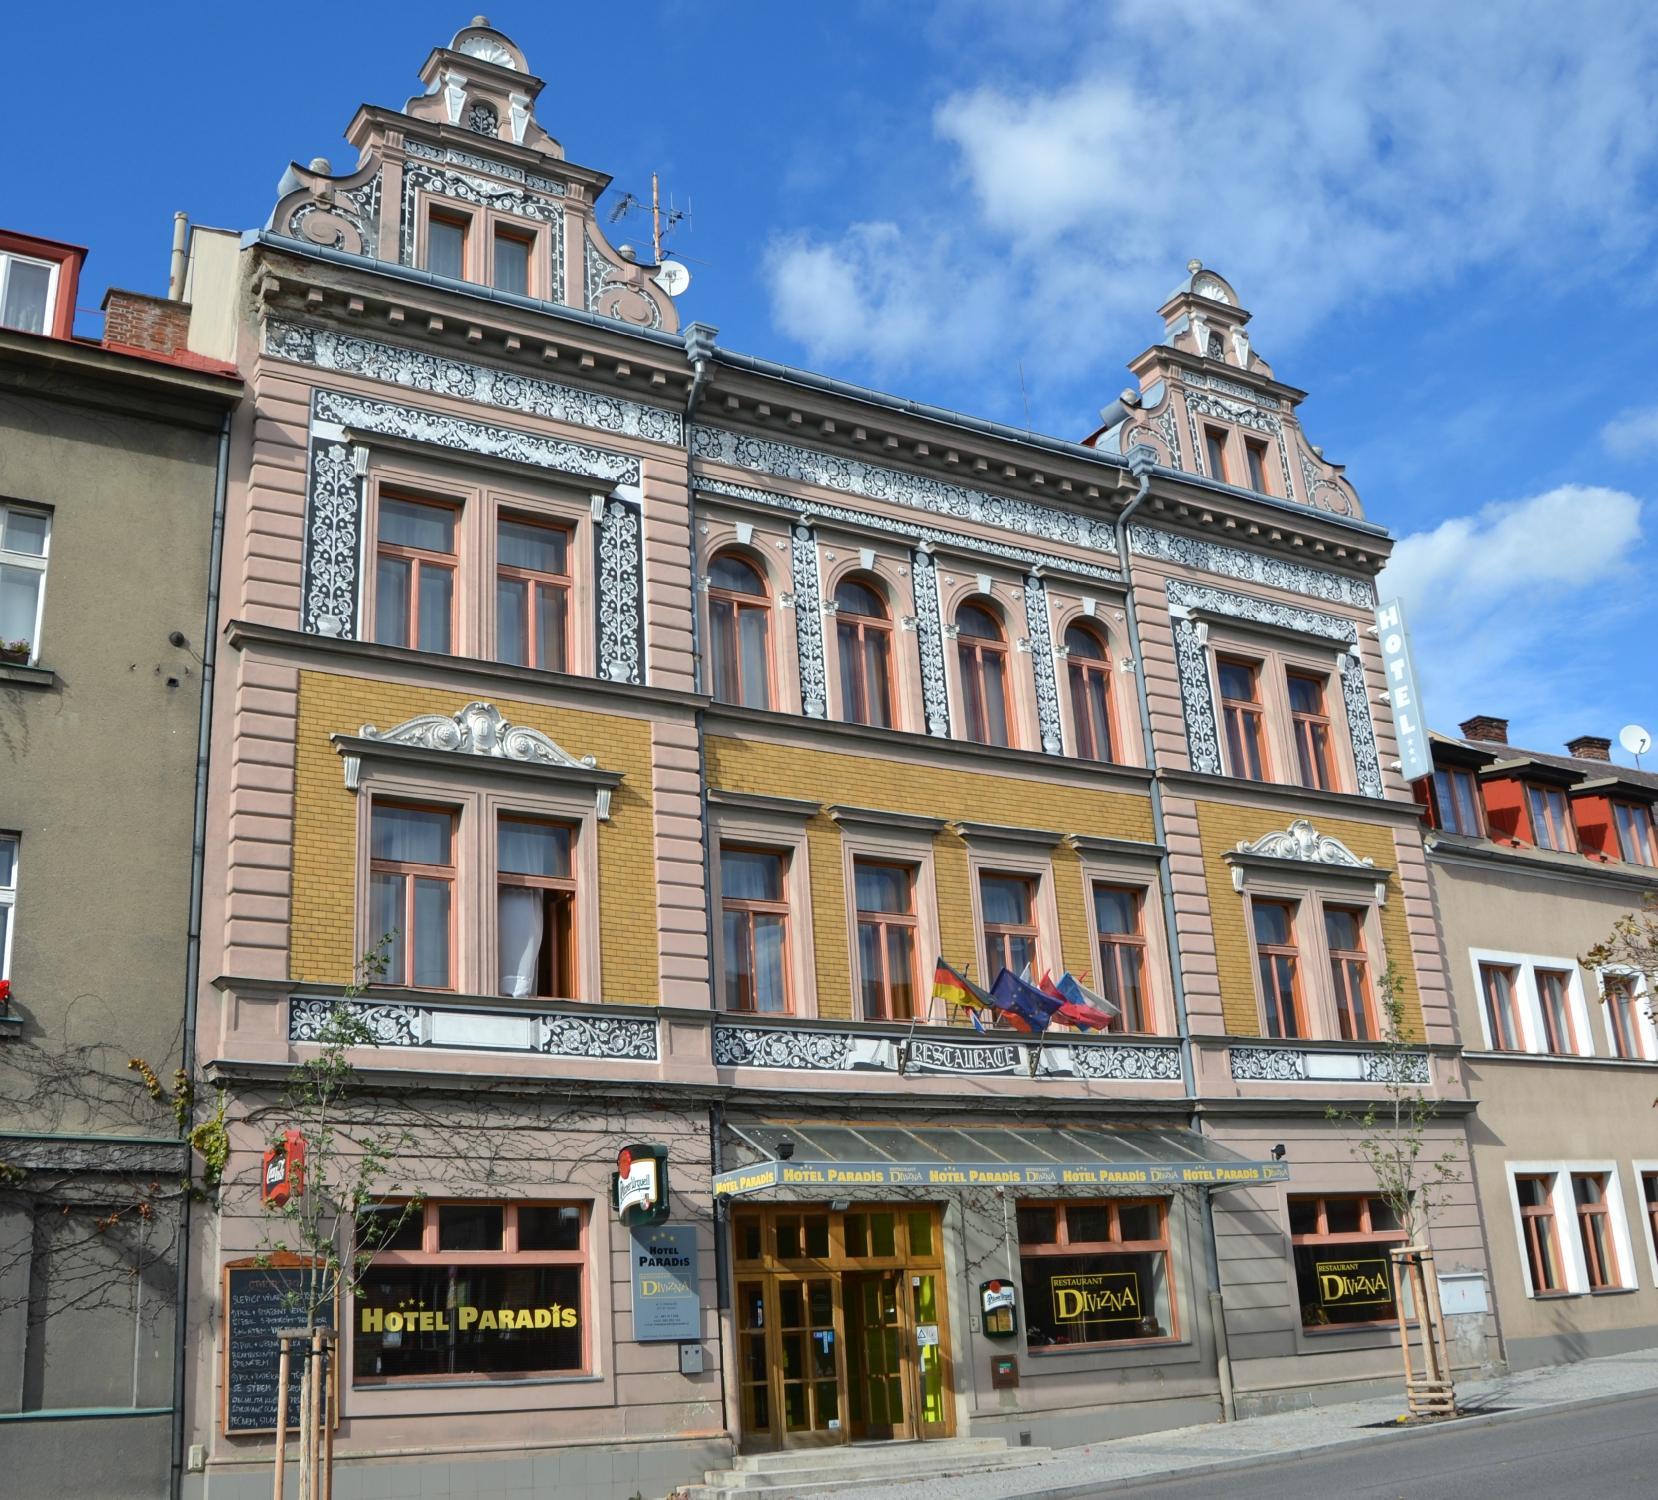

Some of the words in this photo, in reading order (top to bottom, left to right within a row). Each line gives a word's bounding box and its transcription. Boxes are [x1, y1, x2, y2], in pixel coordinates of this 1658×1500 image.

[1378, 605, 1416, 736] HOTEL
[911, 1041, 1016, 1069] RESTAURACE
[783, 1168, 824, 1182] HOTEL
[929, 1169, 967, 1182] HOTEL
[1063, 1169, 1098, 1182] HOTEL
[1183, 1168, 1215, 1181] HOTEL
[715, 1180, 739, 1194] HOTEL
[649, 1246, 680, 1255] HOTEL
[1318, 1263, 1359, 1272] RESTAURANT
[1053, 1277, 1103, 1287] RESTAURANT
[361, 1307, 449, 1332] HOTEL
